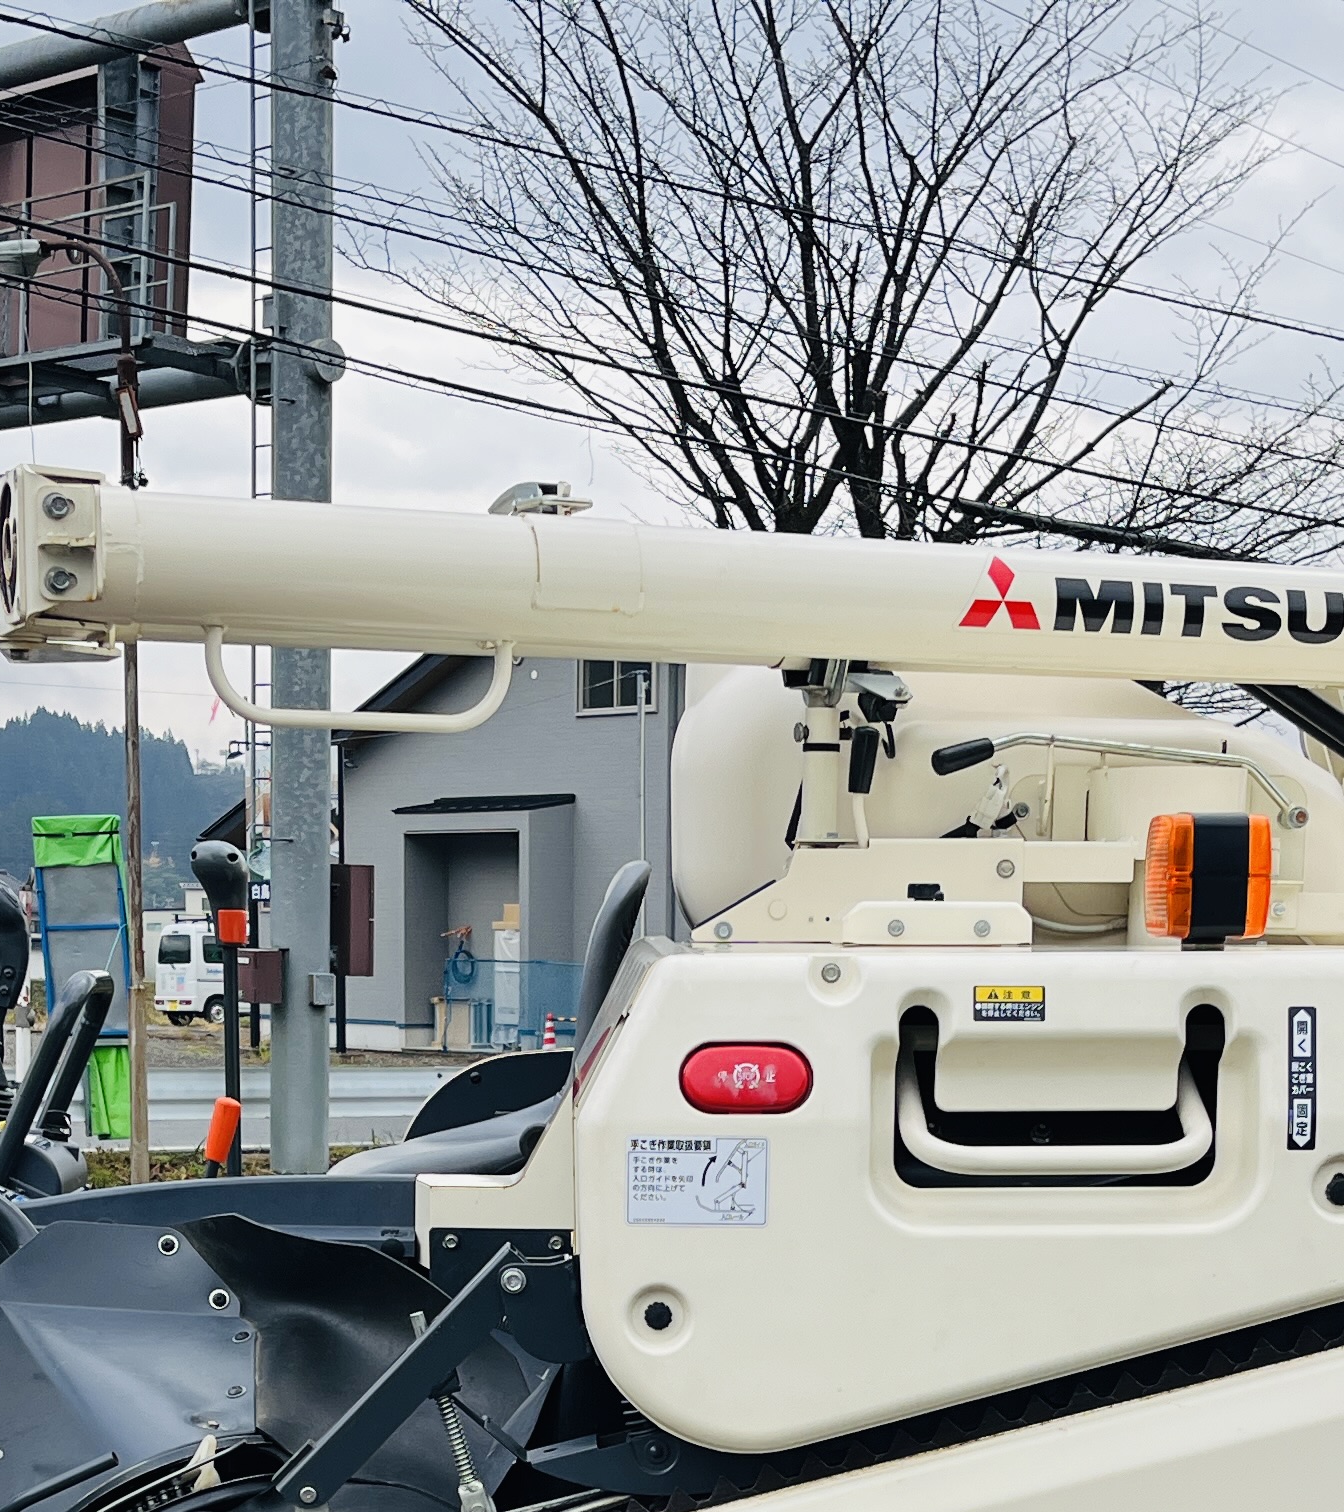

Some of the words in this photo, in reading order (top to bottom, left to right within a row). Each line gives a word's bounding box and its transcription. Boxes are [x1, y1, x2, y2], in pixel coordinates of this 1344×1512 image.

[1297, 1021, 1308, 1052] 開く
[1291, 1085, 1314, 1095] カバー
[1296, 1104, 1308, 1136] 固定
[632, 1184, 686, 1192] の方向に上げて
[632, 1193, 667, 1201] ください。
